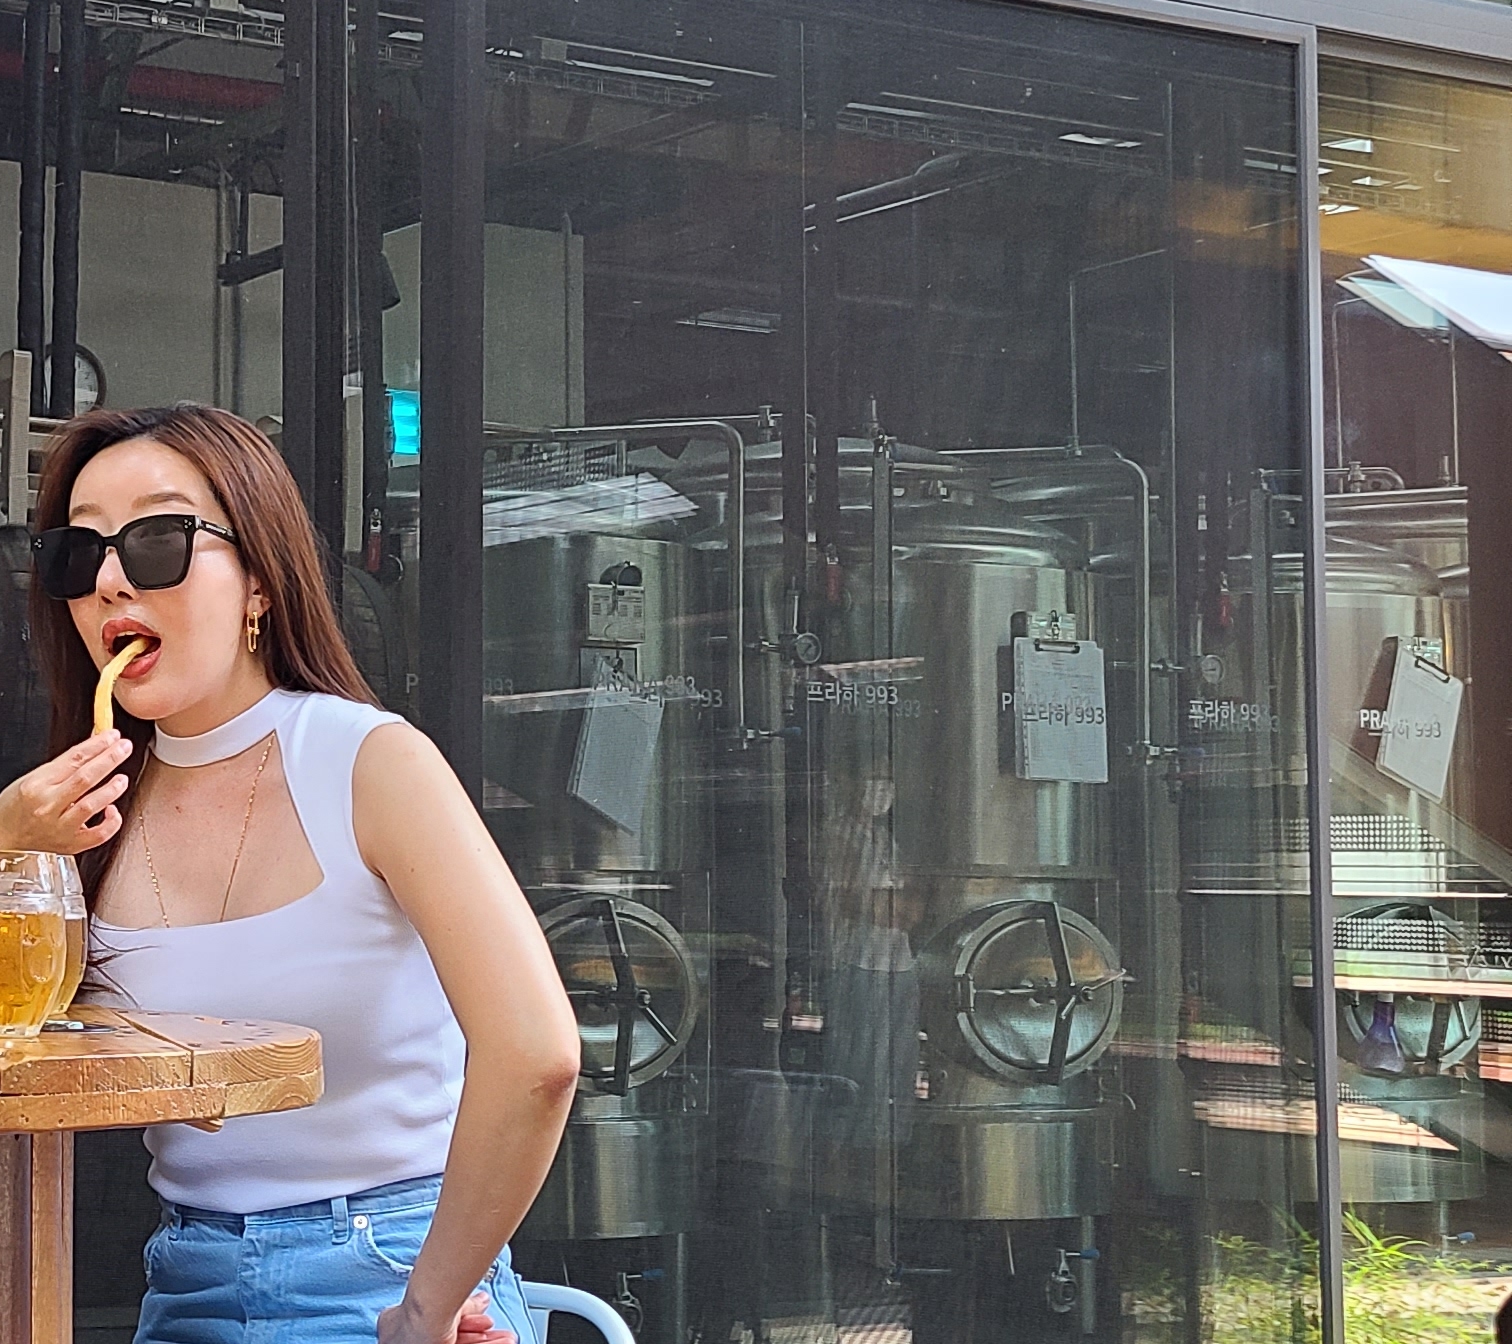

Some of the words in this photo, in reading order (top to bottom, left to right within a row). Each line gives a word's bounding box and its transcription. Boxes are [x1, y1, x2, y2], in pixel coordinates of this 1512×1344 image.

[807, 681, 860, 706] 프라하
[865, 685, 898, 705] 993
[1075, 706, 1105, 725] 993
[1360, 708, 1391, 729] PRA
[1415, 721, 1441, 738] 993
